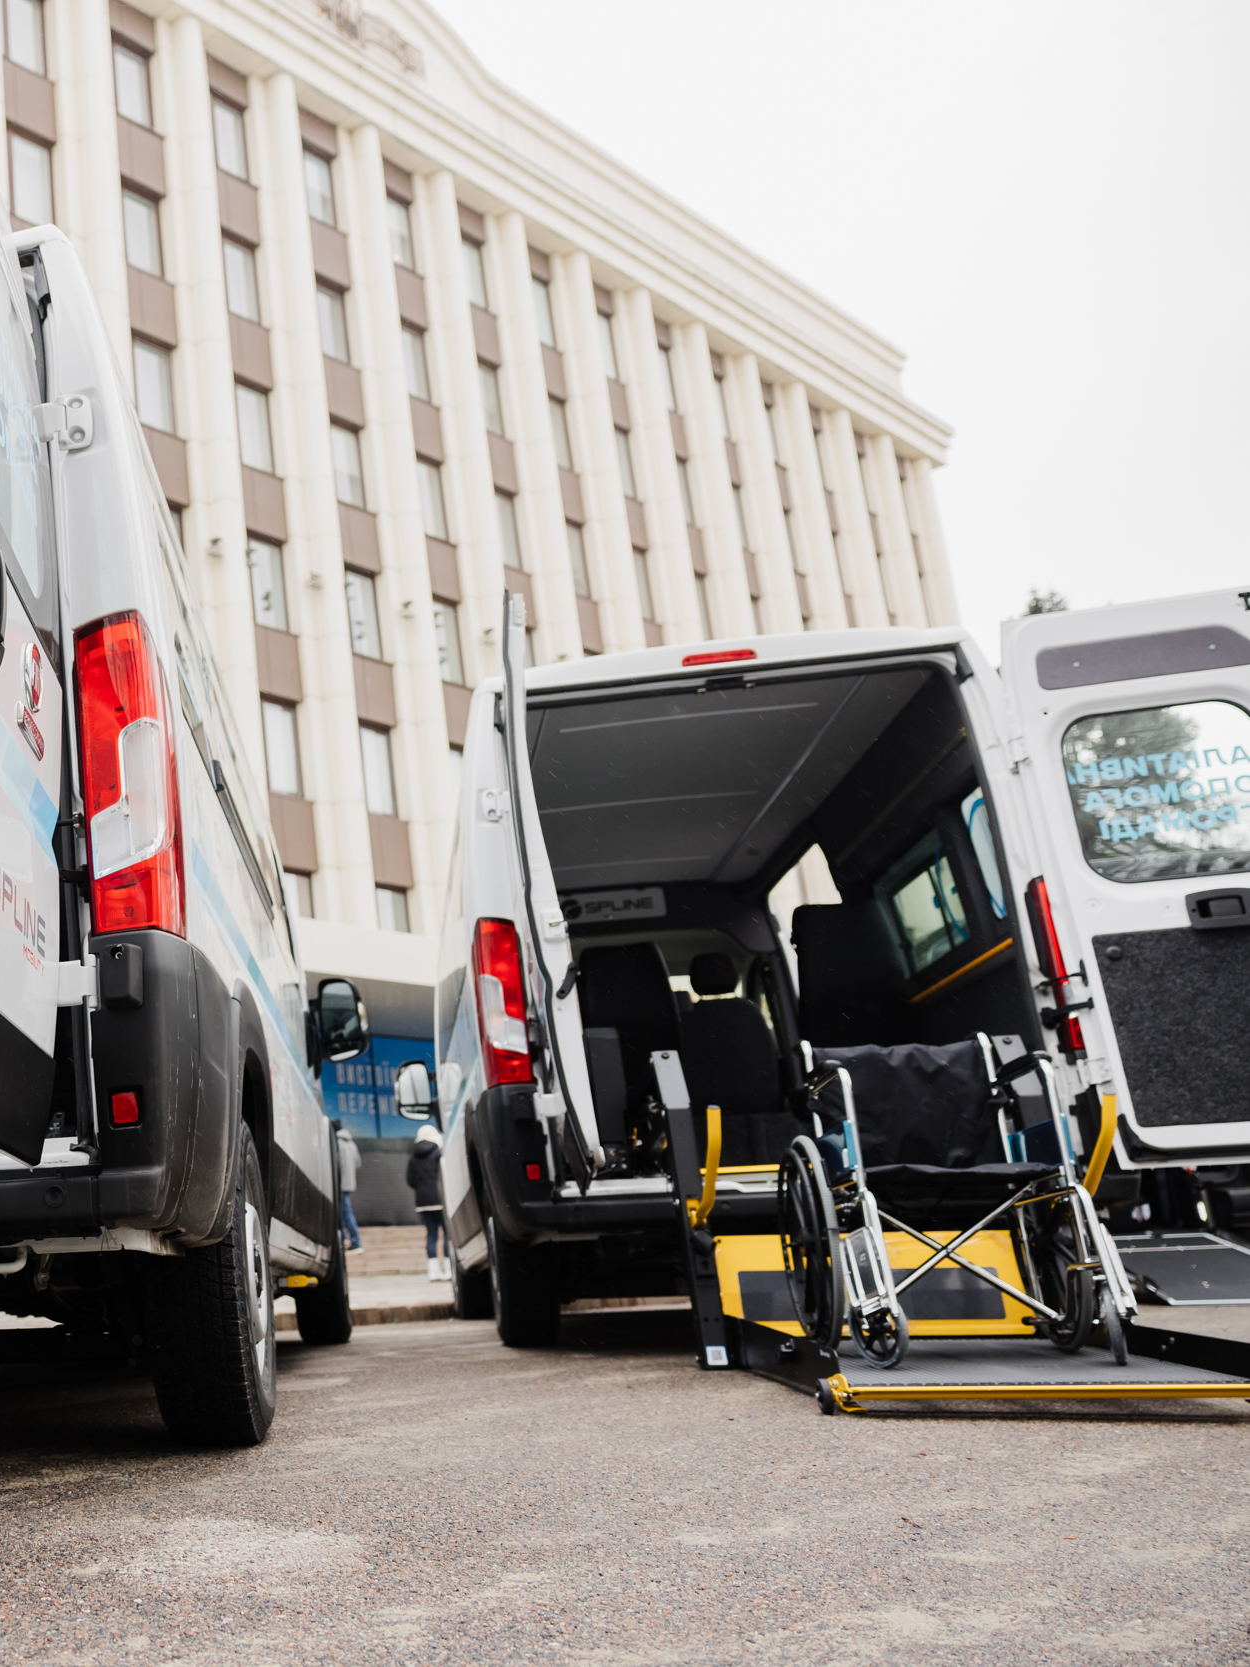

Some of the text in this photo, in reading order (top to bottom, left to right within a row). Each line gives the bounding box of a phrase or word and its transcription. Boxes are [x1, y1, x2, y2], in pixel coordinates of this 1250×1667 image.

[584, 897, 653, 914] SPLINE
[23, 944, 45, 976] MOBILITY
[336, 1061, 399, 1087] ВИСТОЇМ
[338, 1092, 399, 1116] ПЕРЕМО
